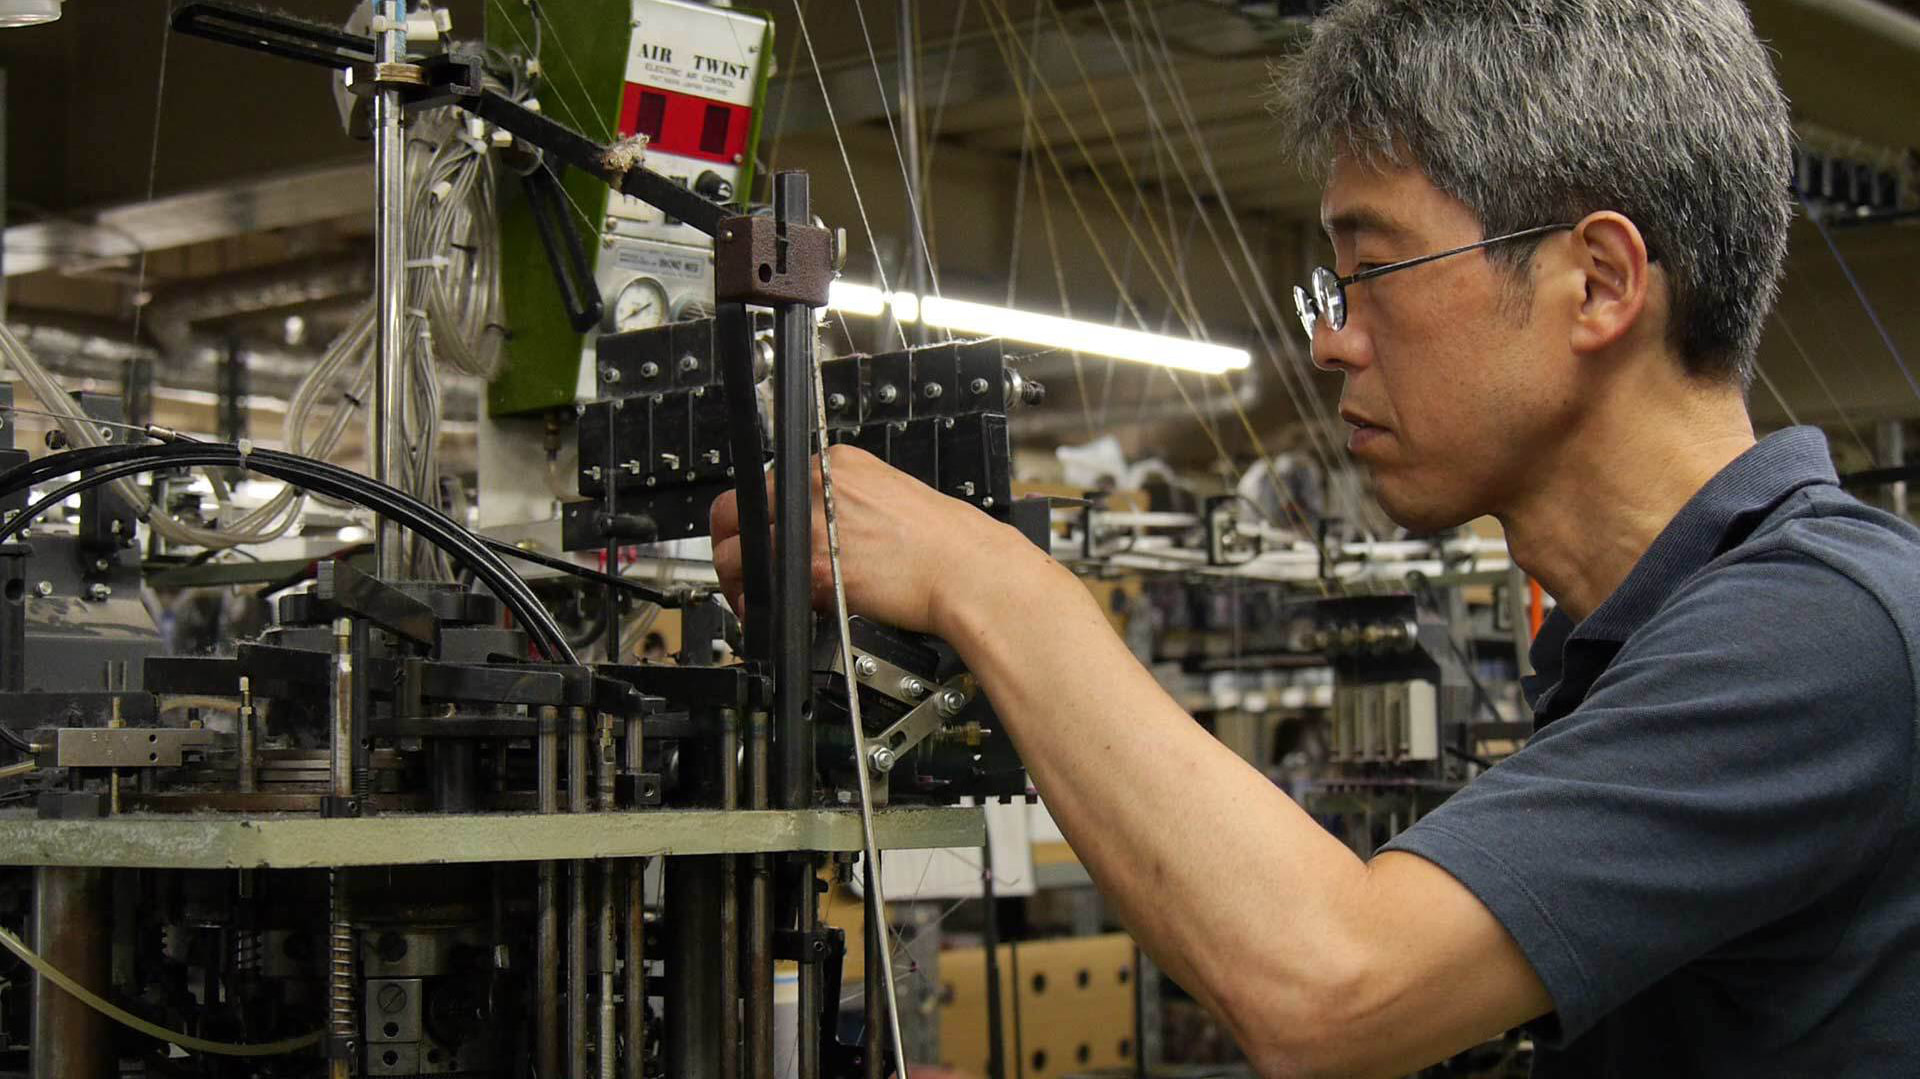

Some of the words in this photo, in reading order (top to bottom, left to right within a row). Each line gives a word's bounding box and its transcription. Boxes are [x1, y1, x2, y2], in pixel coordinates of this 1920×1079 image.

[638, 43, 672, 63] AIR
[694, 55, 749, 80] TWIST
[644, 62, 681, 77] ELECTRIC
[702, 75, 735, 88] CONTROL
